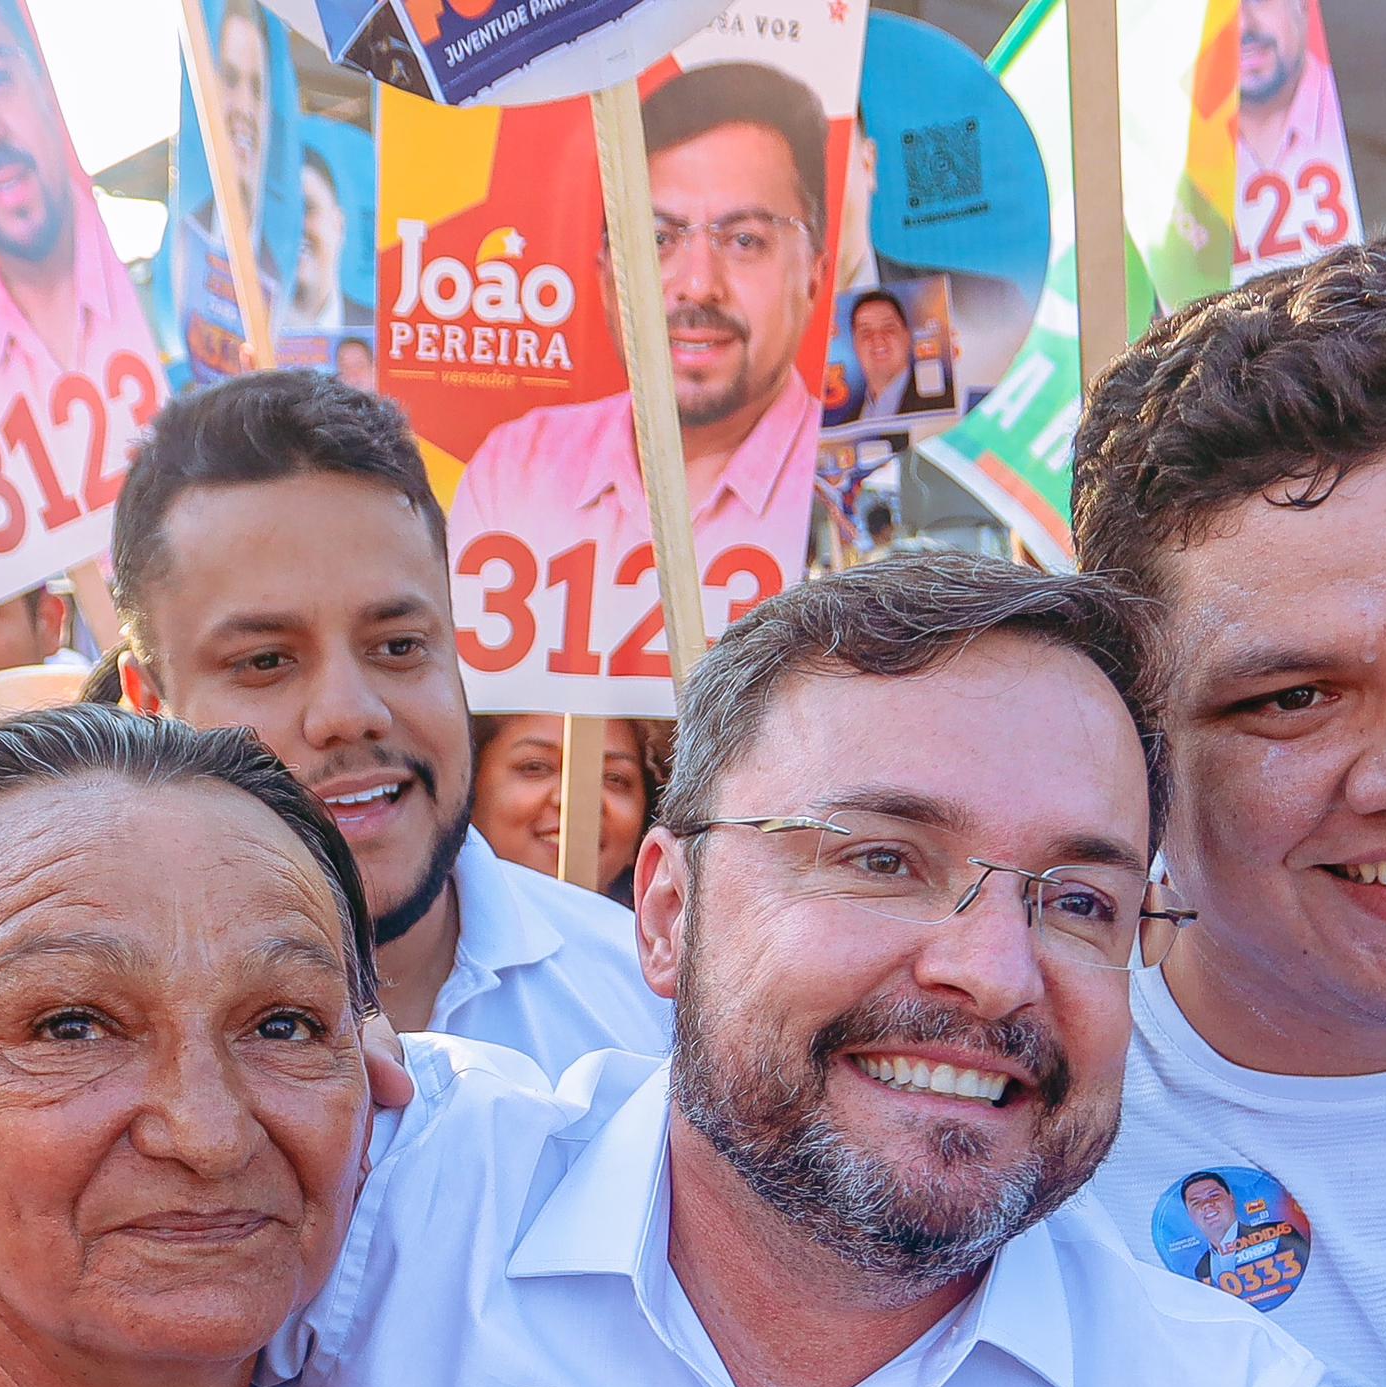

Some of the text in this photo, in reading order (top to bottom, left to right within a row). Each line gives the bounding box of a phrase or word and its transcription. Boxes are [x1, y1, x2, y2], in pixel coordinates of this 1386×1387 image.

[444, 5, 529, 67] JUVENTUDE
[1233, 161, 1349, 265] 23
[392, 218, 576, 327] João
[389, 322, 574, 370] PEREIRA
[1201, 1248, 1301, 1296] 0333
